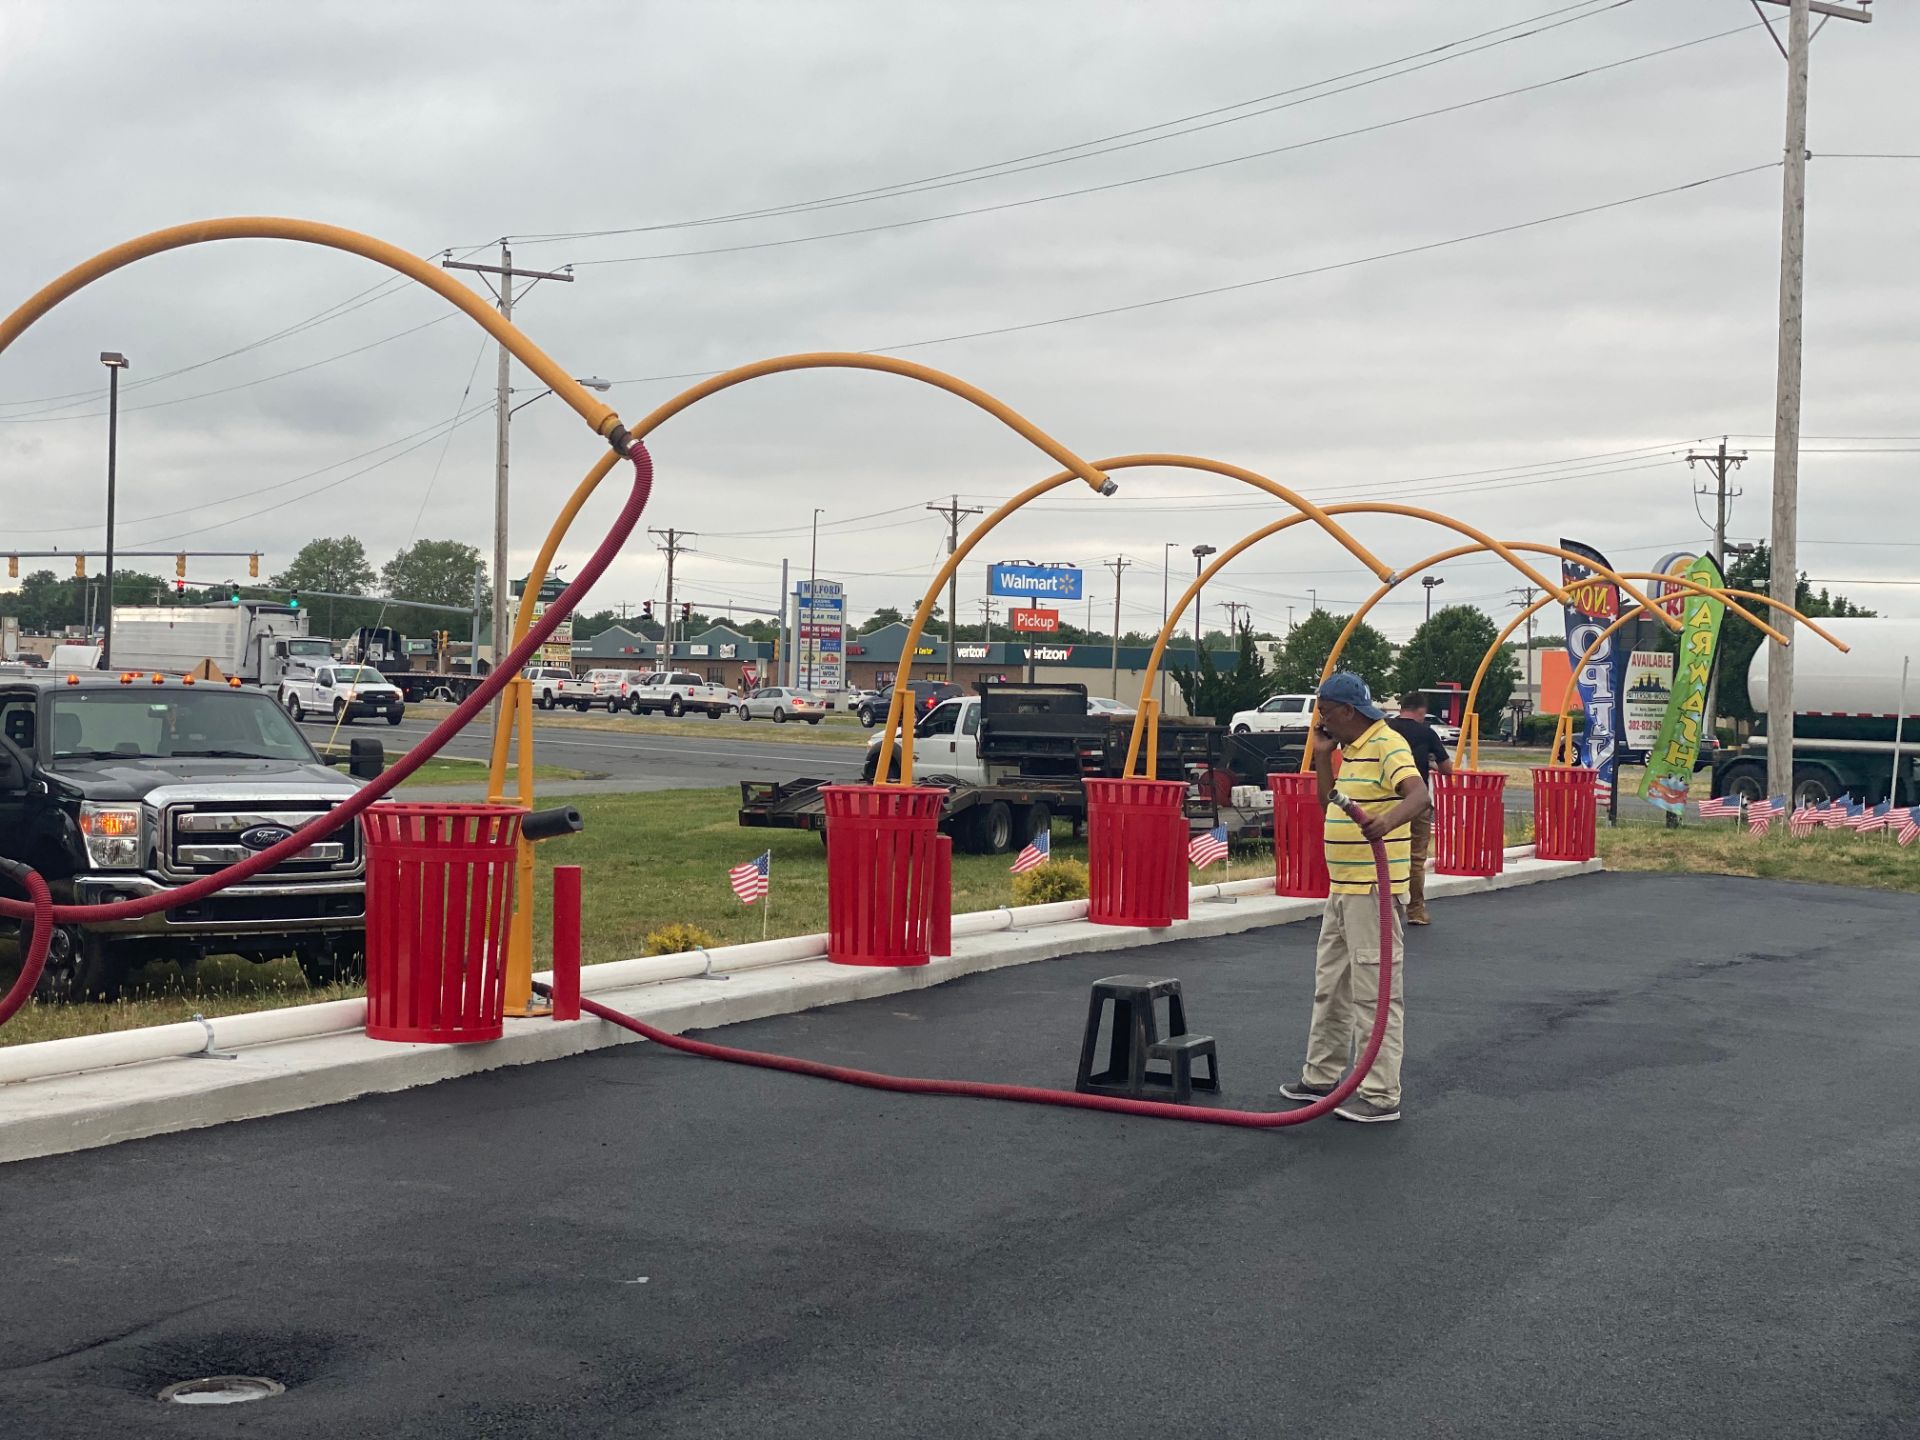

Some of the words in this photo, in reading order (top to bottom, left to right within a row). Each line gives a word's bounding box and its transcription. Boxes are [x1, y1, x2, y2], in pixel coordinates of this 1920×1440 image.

[803, 583, 840, 594] MLFORD
[1000, 572, 1057, 592] Walmart
[1017, 613, 1054, 631] Pickup
[957, 644, 986, 658] verizon
[1631, 652, 1673, 669] AVAILABLE
[254, 830, 284, 843] Ford
